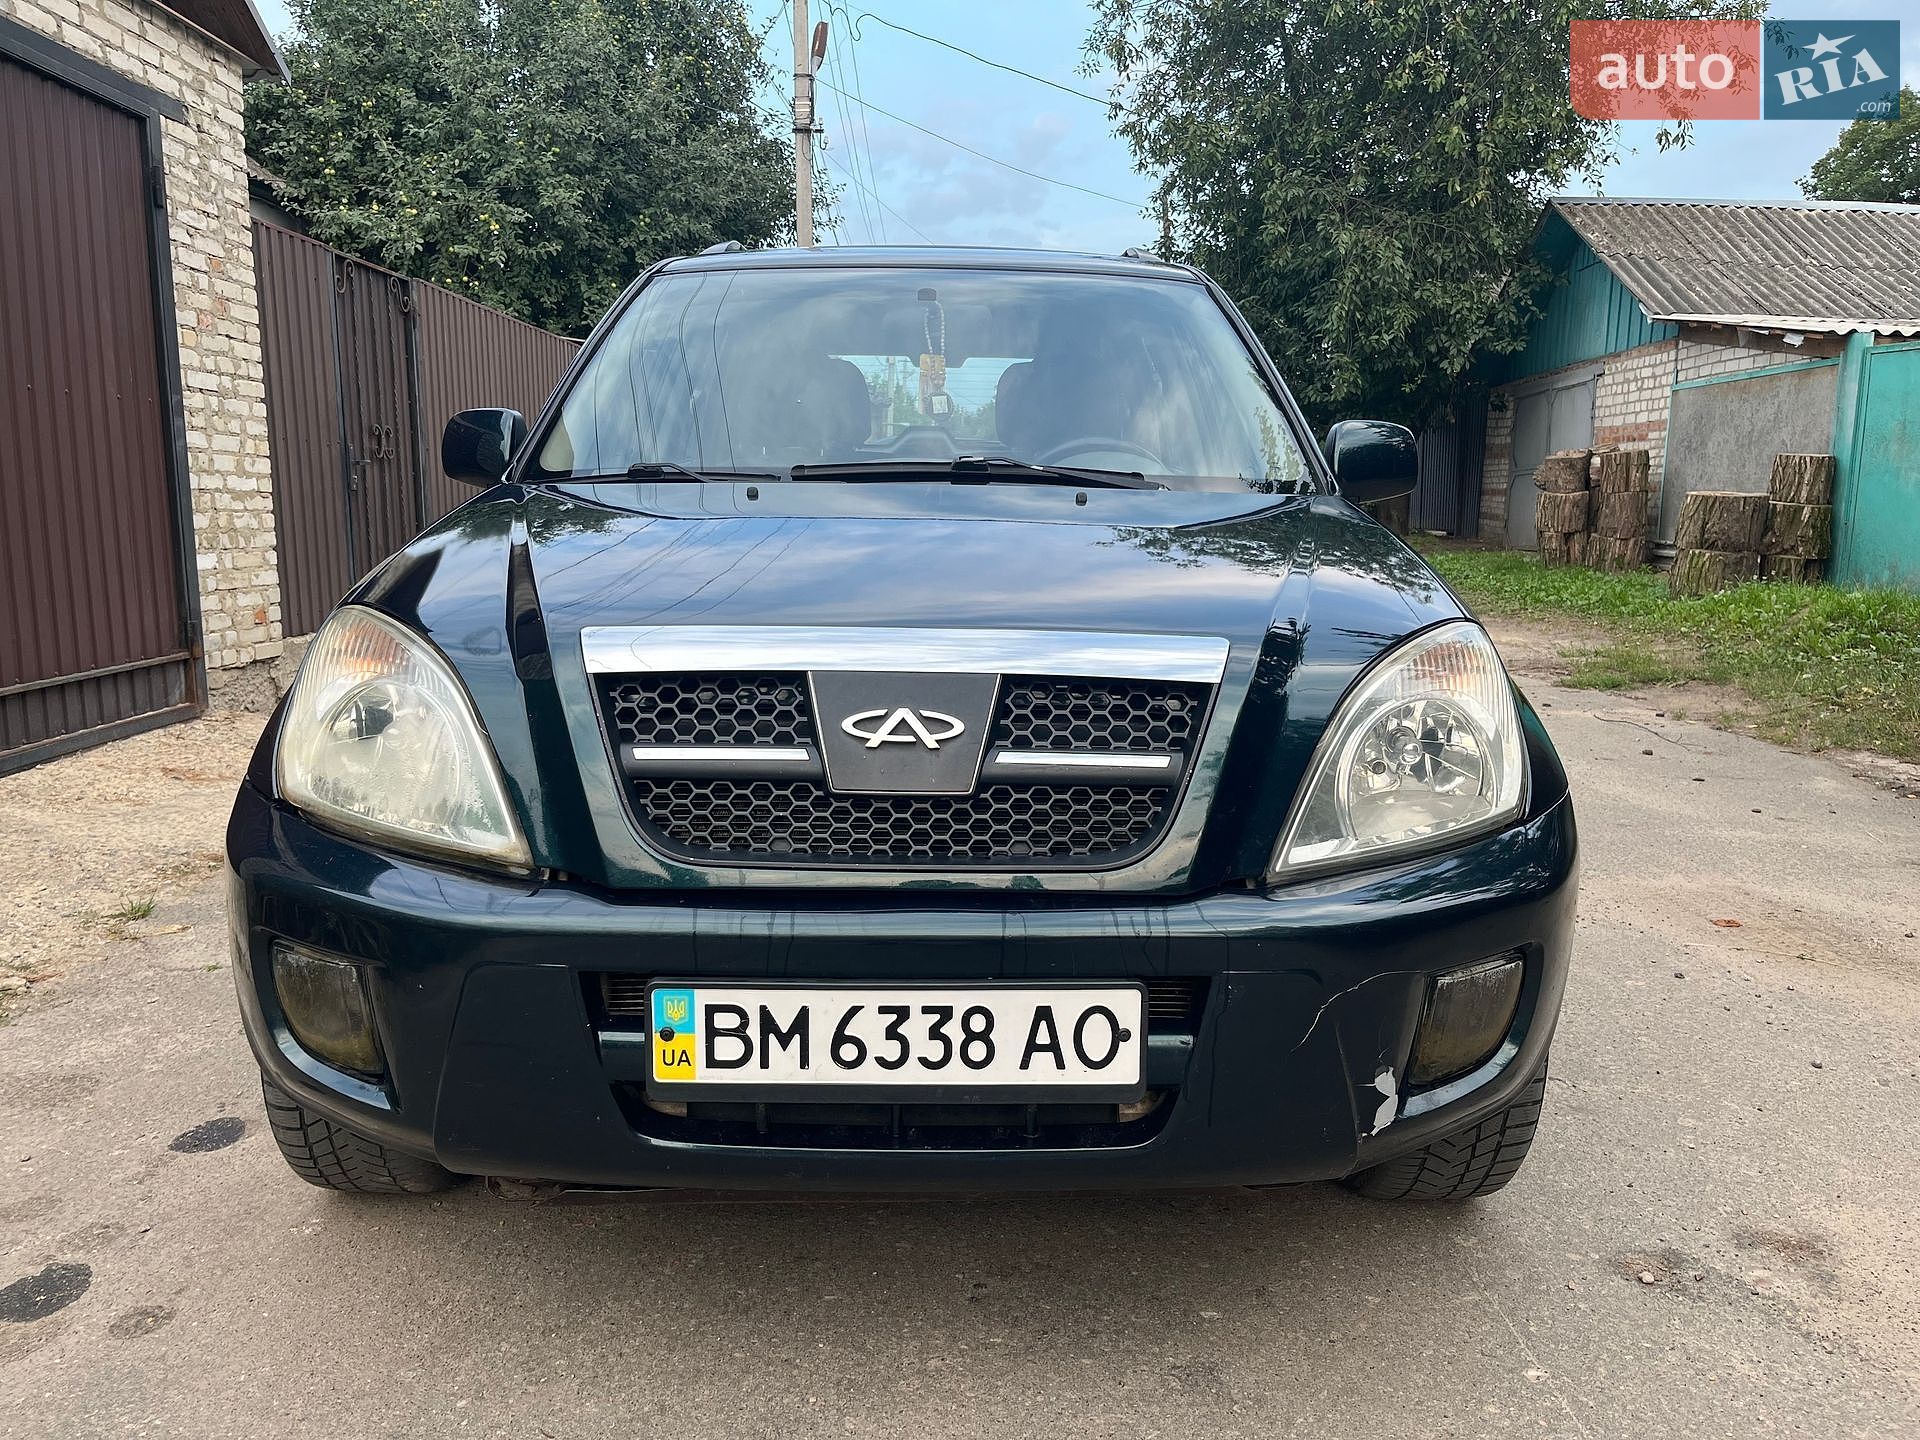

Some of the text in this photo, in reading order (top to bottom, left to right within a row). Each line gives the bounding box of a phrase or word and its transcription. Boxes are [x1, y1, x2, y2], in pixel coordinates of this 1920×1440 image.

[662, 1049, 692, 1067] UA
[704, 1004, 1121, 1071] BM 6338 AO
